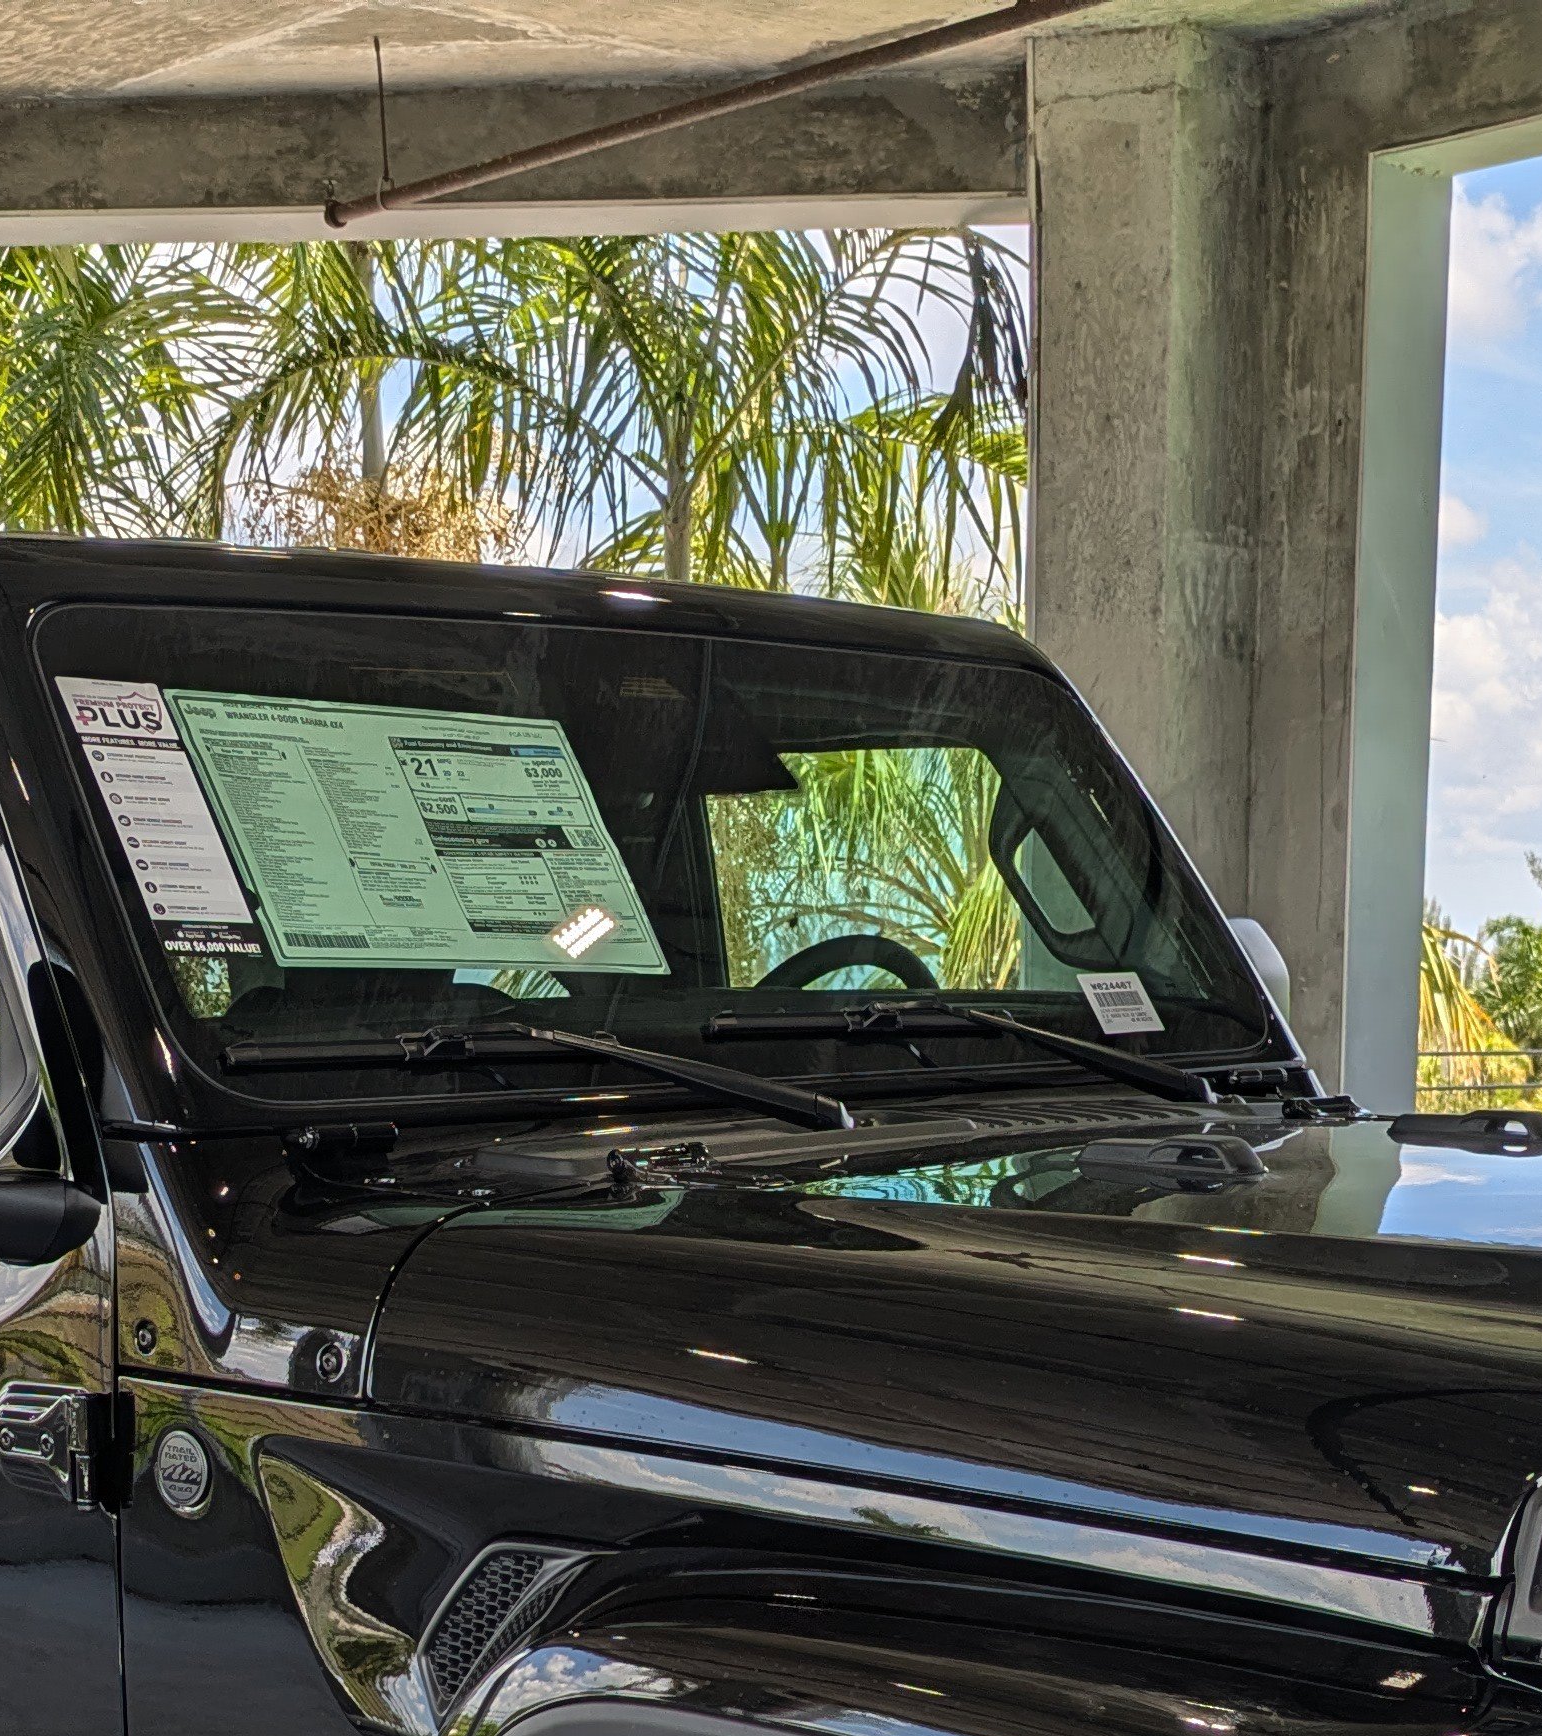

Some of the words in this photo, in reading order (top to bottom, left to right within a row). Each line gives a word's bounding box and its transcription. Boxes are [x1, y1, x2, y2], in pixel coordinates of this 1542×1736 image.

[72, 698, 114, 707] PREMIUM
[115, 701, 156, 711] PROTECT
[181, 703, 218, 719] Jeep
[76, 705, 164, 730] PLUS
[225, 711, 270, 721] WRANGLER
[269, 714, 299, 723] 4-DOOR
[299, 717, 329, 727] SAHARA
[410, 757, 438, 776] 21
[530, 758, 557, 768] spend
[524, 766, 563, 779] $3,000
[419, 802, 459, 814] $2,500
[163, 941, 192, 950] OVER
[191, 941, 227, 952] $6,000
[225, 942, 262, 953] VALUE!
[167, 1444, 195, 1455] TRAIL
[165, 1452, 198, 1462] RATED
[168, 1484, 193, 1494] 4x4
